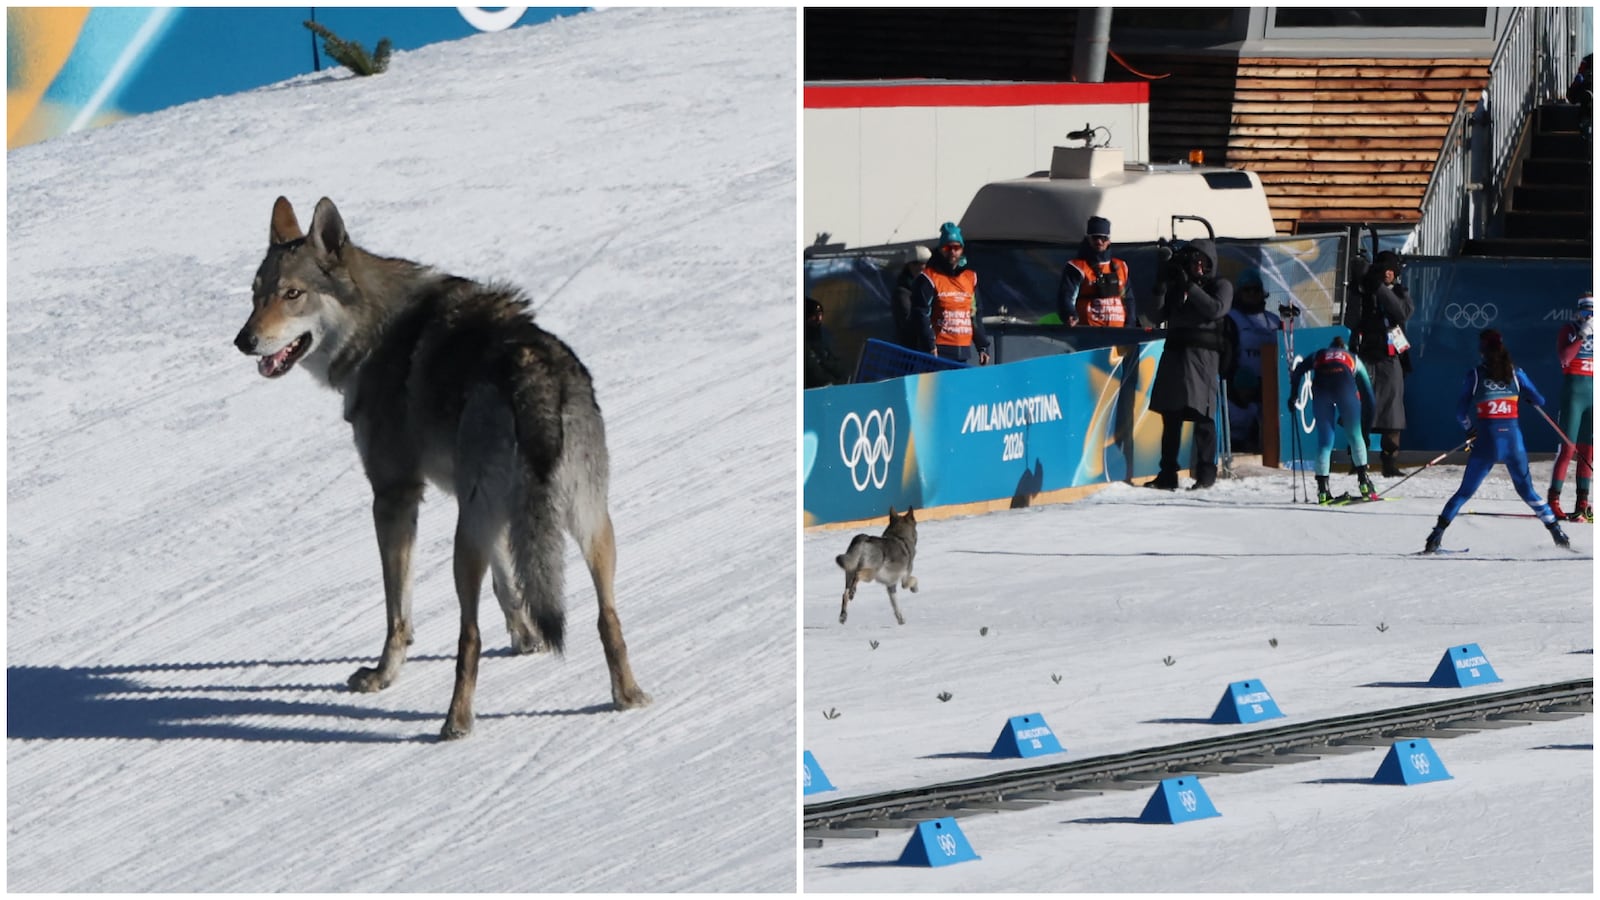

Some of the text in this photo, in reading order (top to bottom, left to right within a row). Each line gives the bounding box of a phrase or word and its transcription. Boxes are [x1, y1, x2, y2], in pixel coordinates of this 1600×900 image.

[961, 393, 1063, 434] MILANO CORTINA
[1003, 432, 1024, 462] 2026
